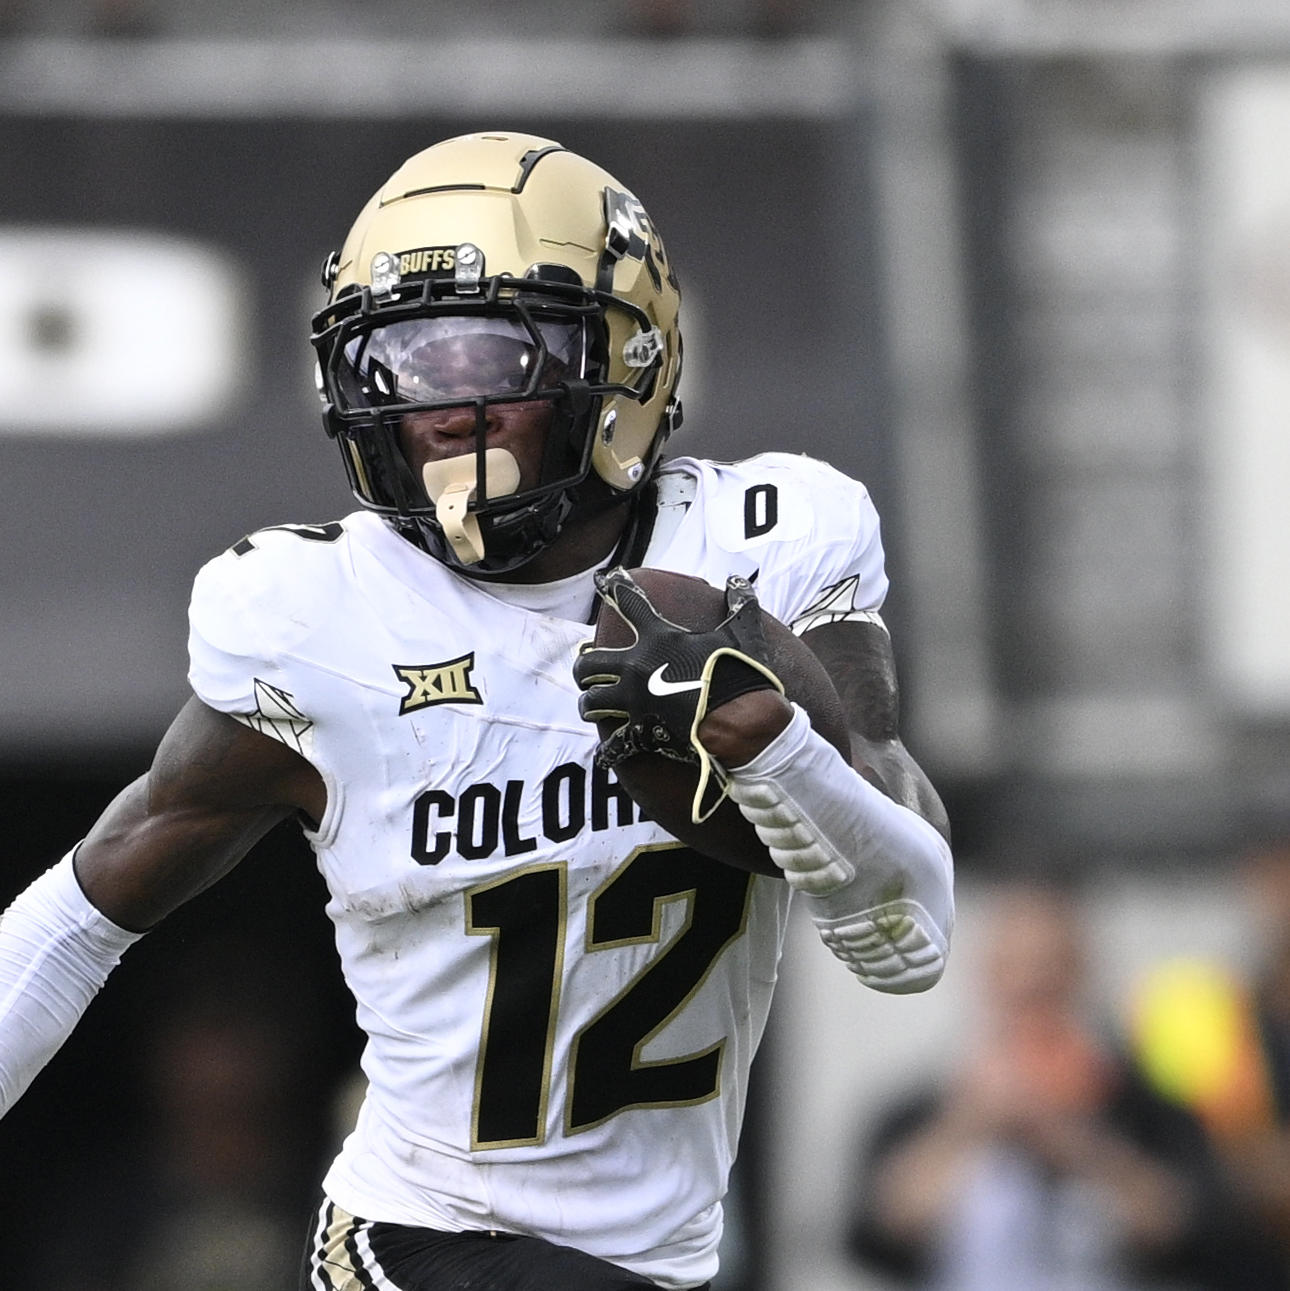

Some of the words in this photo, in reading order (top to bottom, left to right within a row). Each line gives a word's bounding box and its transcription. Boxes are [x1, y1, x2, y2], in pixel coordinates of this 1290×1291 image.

[399, 249, 456, 276] BUFFS
[396, 656, 479, 712] XII
[410, 761, 653, 866] COLOR
[463, 841, 757, 1152] 12
